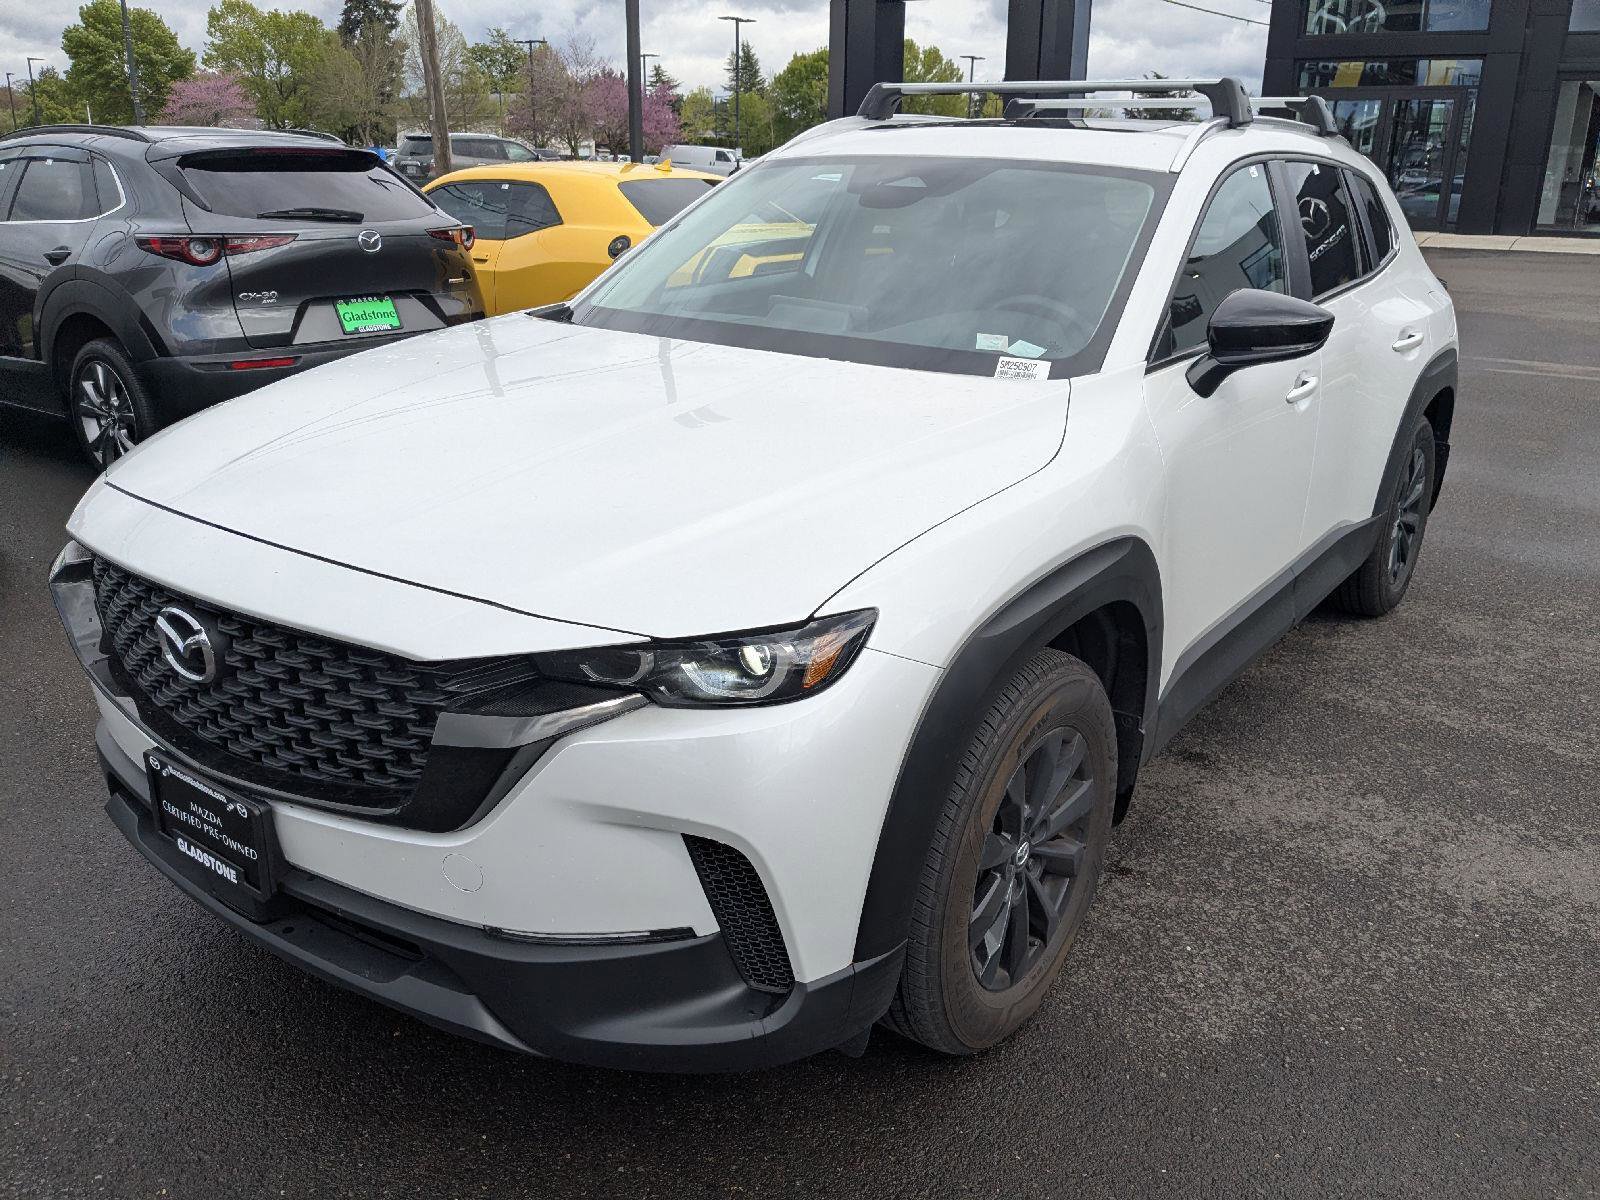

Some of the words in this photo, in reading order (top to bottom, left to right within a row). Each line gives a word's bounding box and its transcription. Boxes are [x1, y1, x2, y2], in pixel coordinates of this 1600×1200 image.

[239, 291, 278, 300] CX-30
[350, 296, 378, 304] MAZDA
[342, 310, 396, 323] Gladstone
[359, 324, 392, 333] GLADSTONE
[190, 801, 223, 828] MAZDA
[162, 800, 202, 830] CERTIFIED
[203, 823, 258, 860] PRE-OWNED
[177, 838, 238, 884] GLADSTONE
